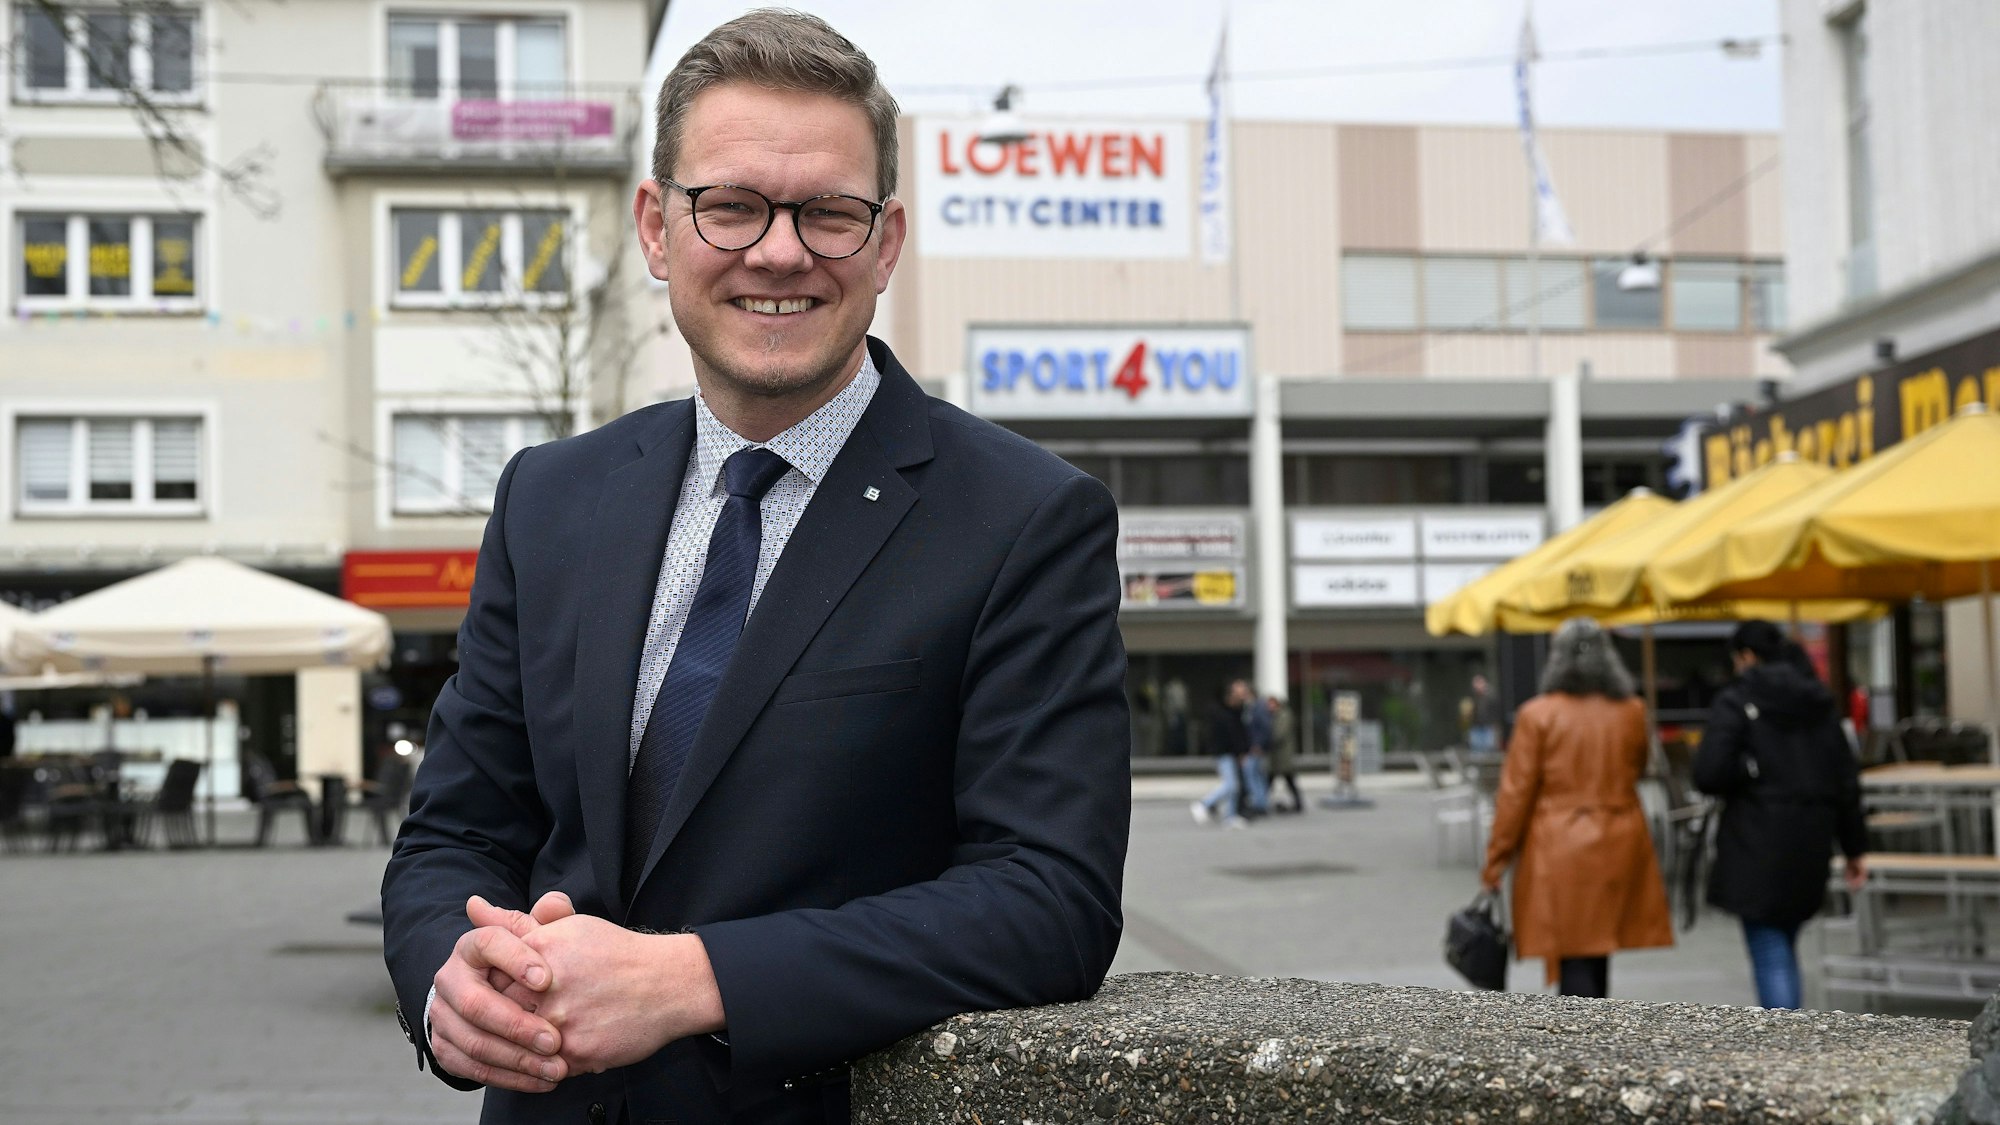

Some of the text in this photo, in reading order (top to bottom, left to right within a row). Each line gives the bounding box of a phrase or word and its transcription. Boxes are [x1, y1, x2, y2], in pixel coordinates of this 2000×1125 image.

[940, 132, 1164, 177] LOEWEN
[942, 195, 1164, 227] CITY CENTER
